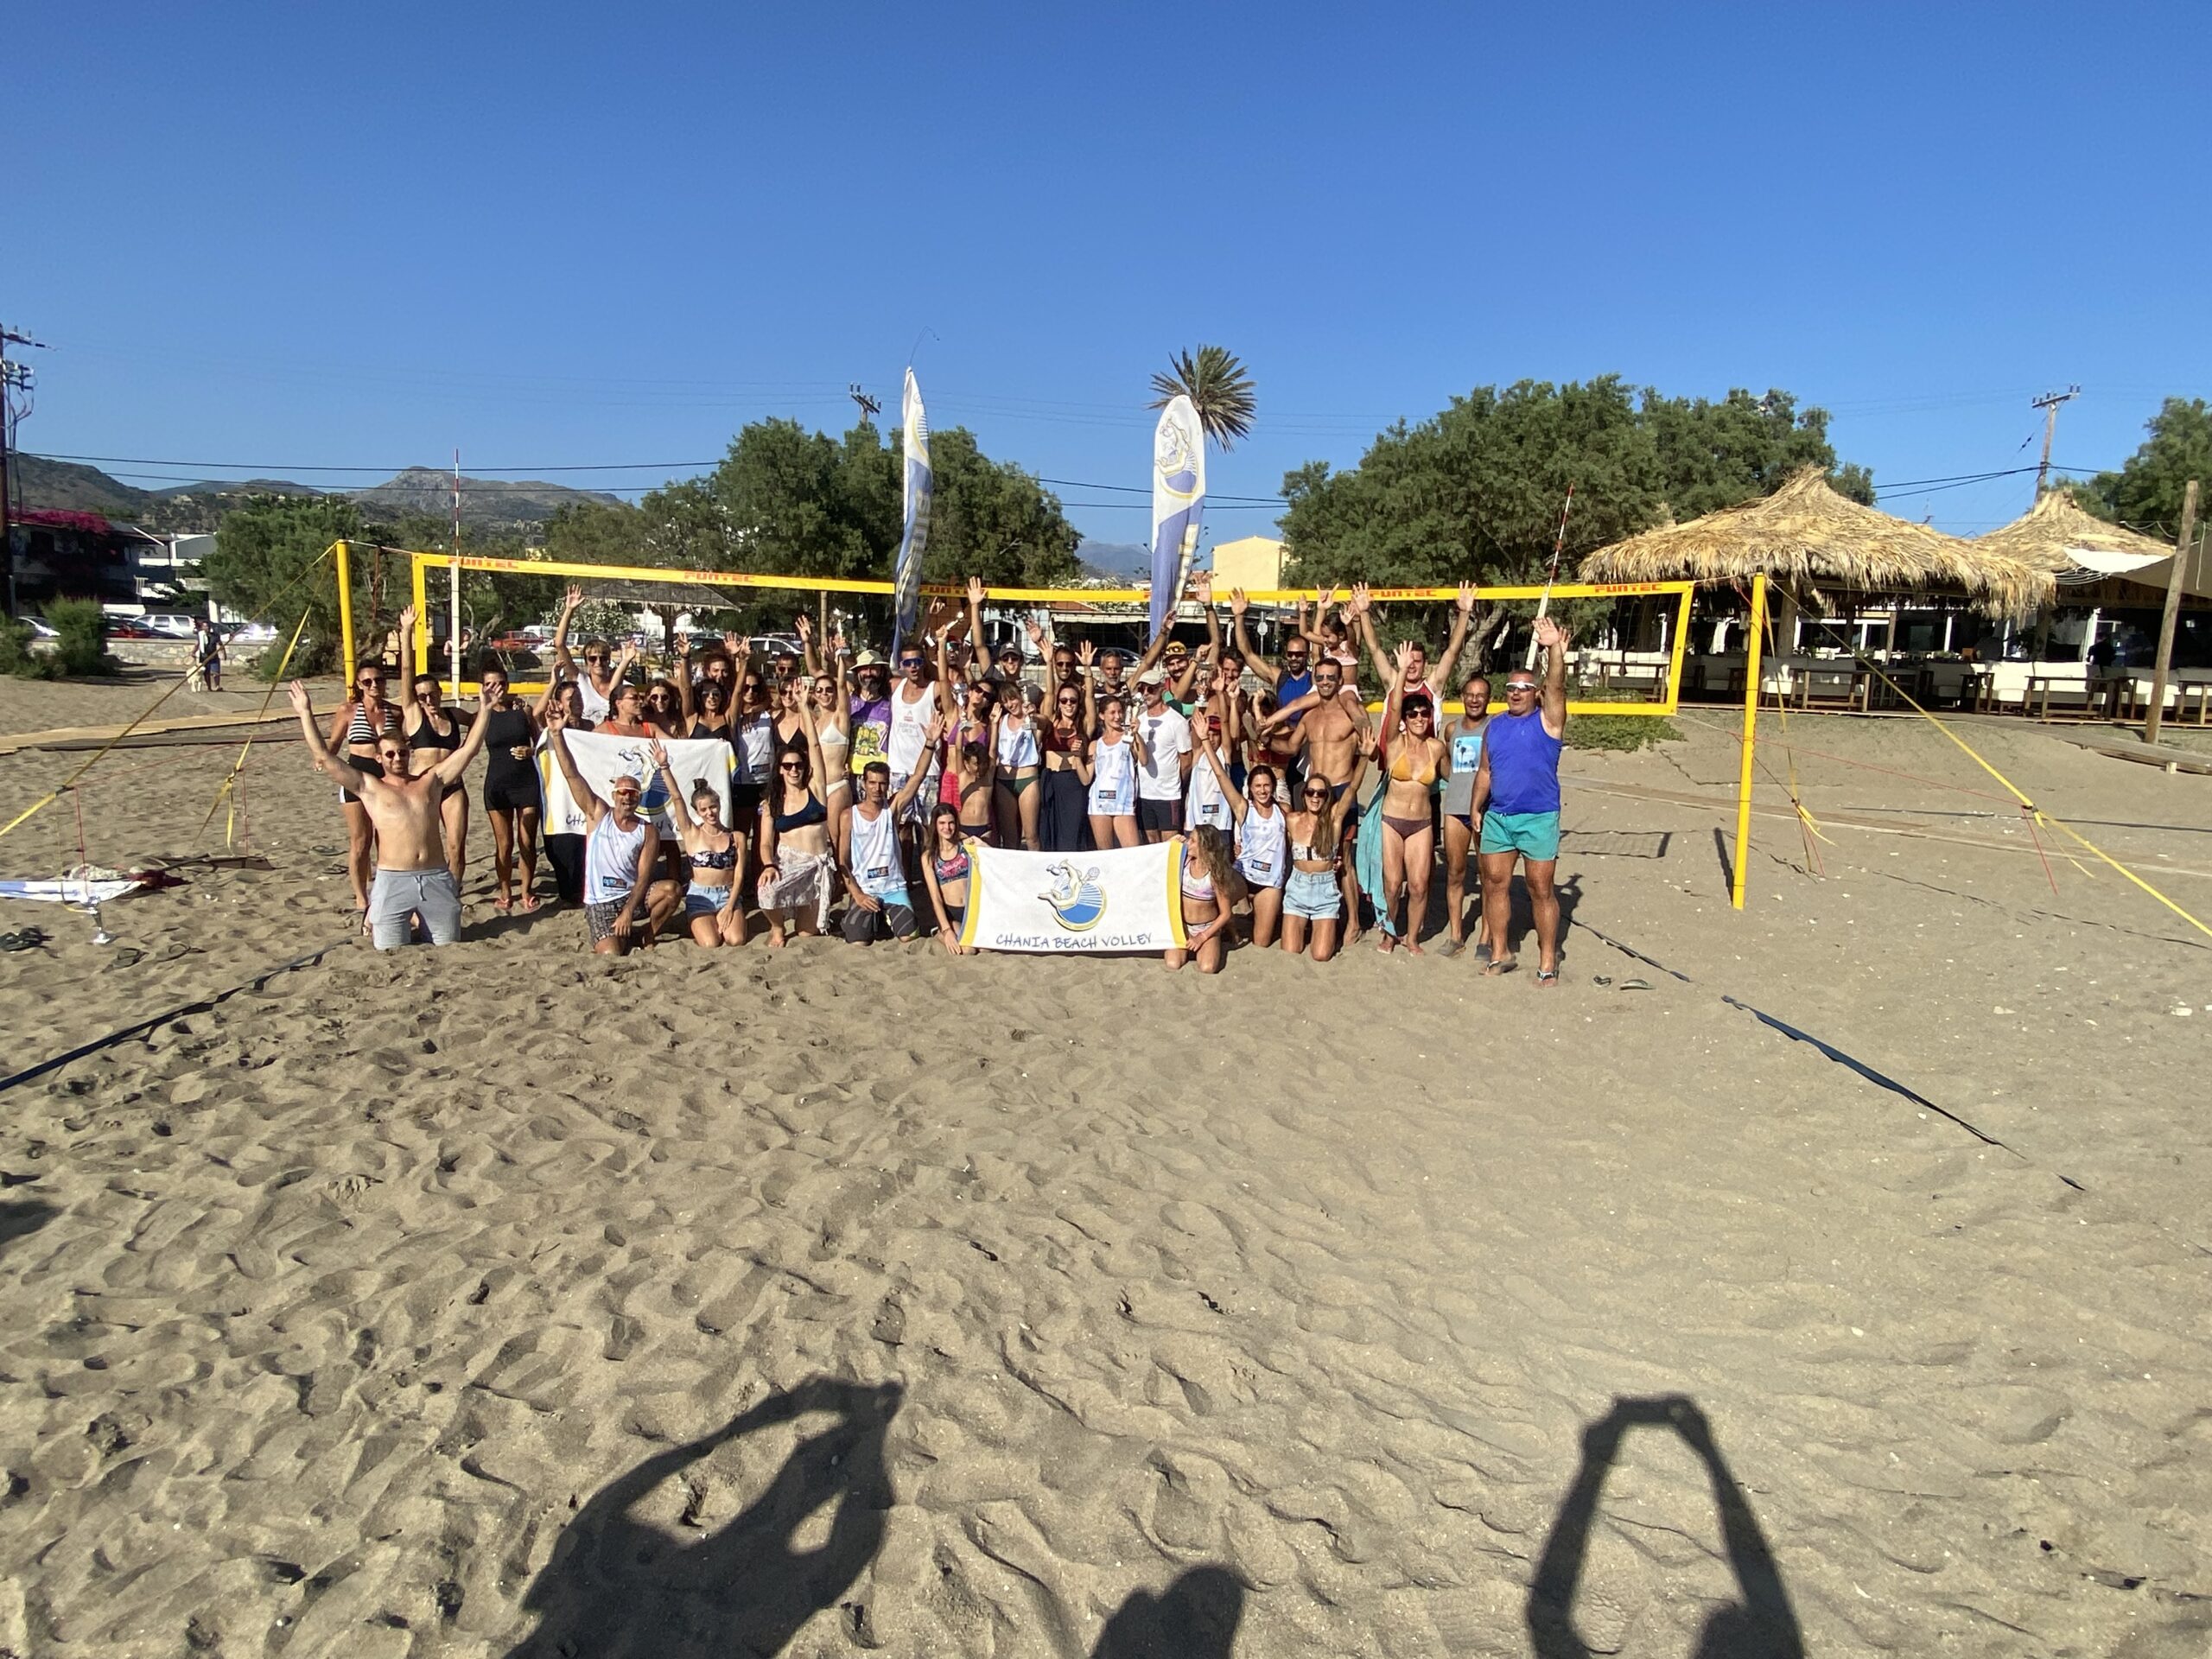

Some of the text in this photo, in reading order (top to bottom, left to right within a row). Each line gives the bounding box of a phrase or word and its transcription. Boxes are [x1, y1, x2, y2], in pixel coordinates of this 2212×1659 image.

[684, 571, 755, 582] FUNTEC
[1370, 589, 1437, 598] FUNTEC
[1595, 583, 1662, 594] FUNTEC
[995, 931, 1152, 950] CHANIA BEACH VOLLEY
